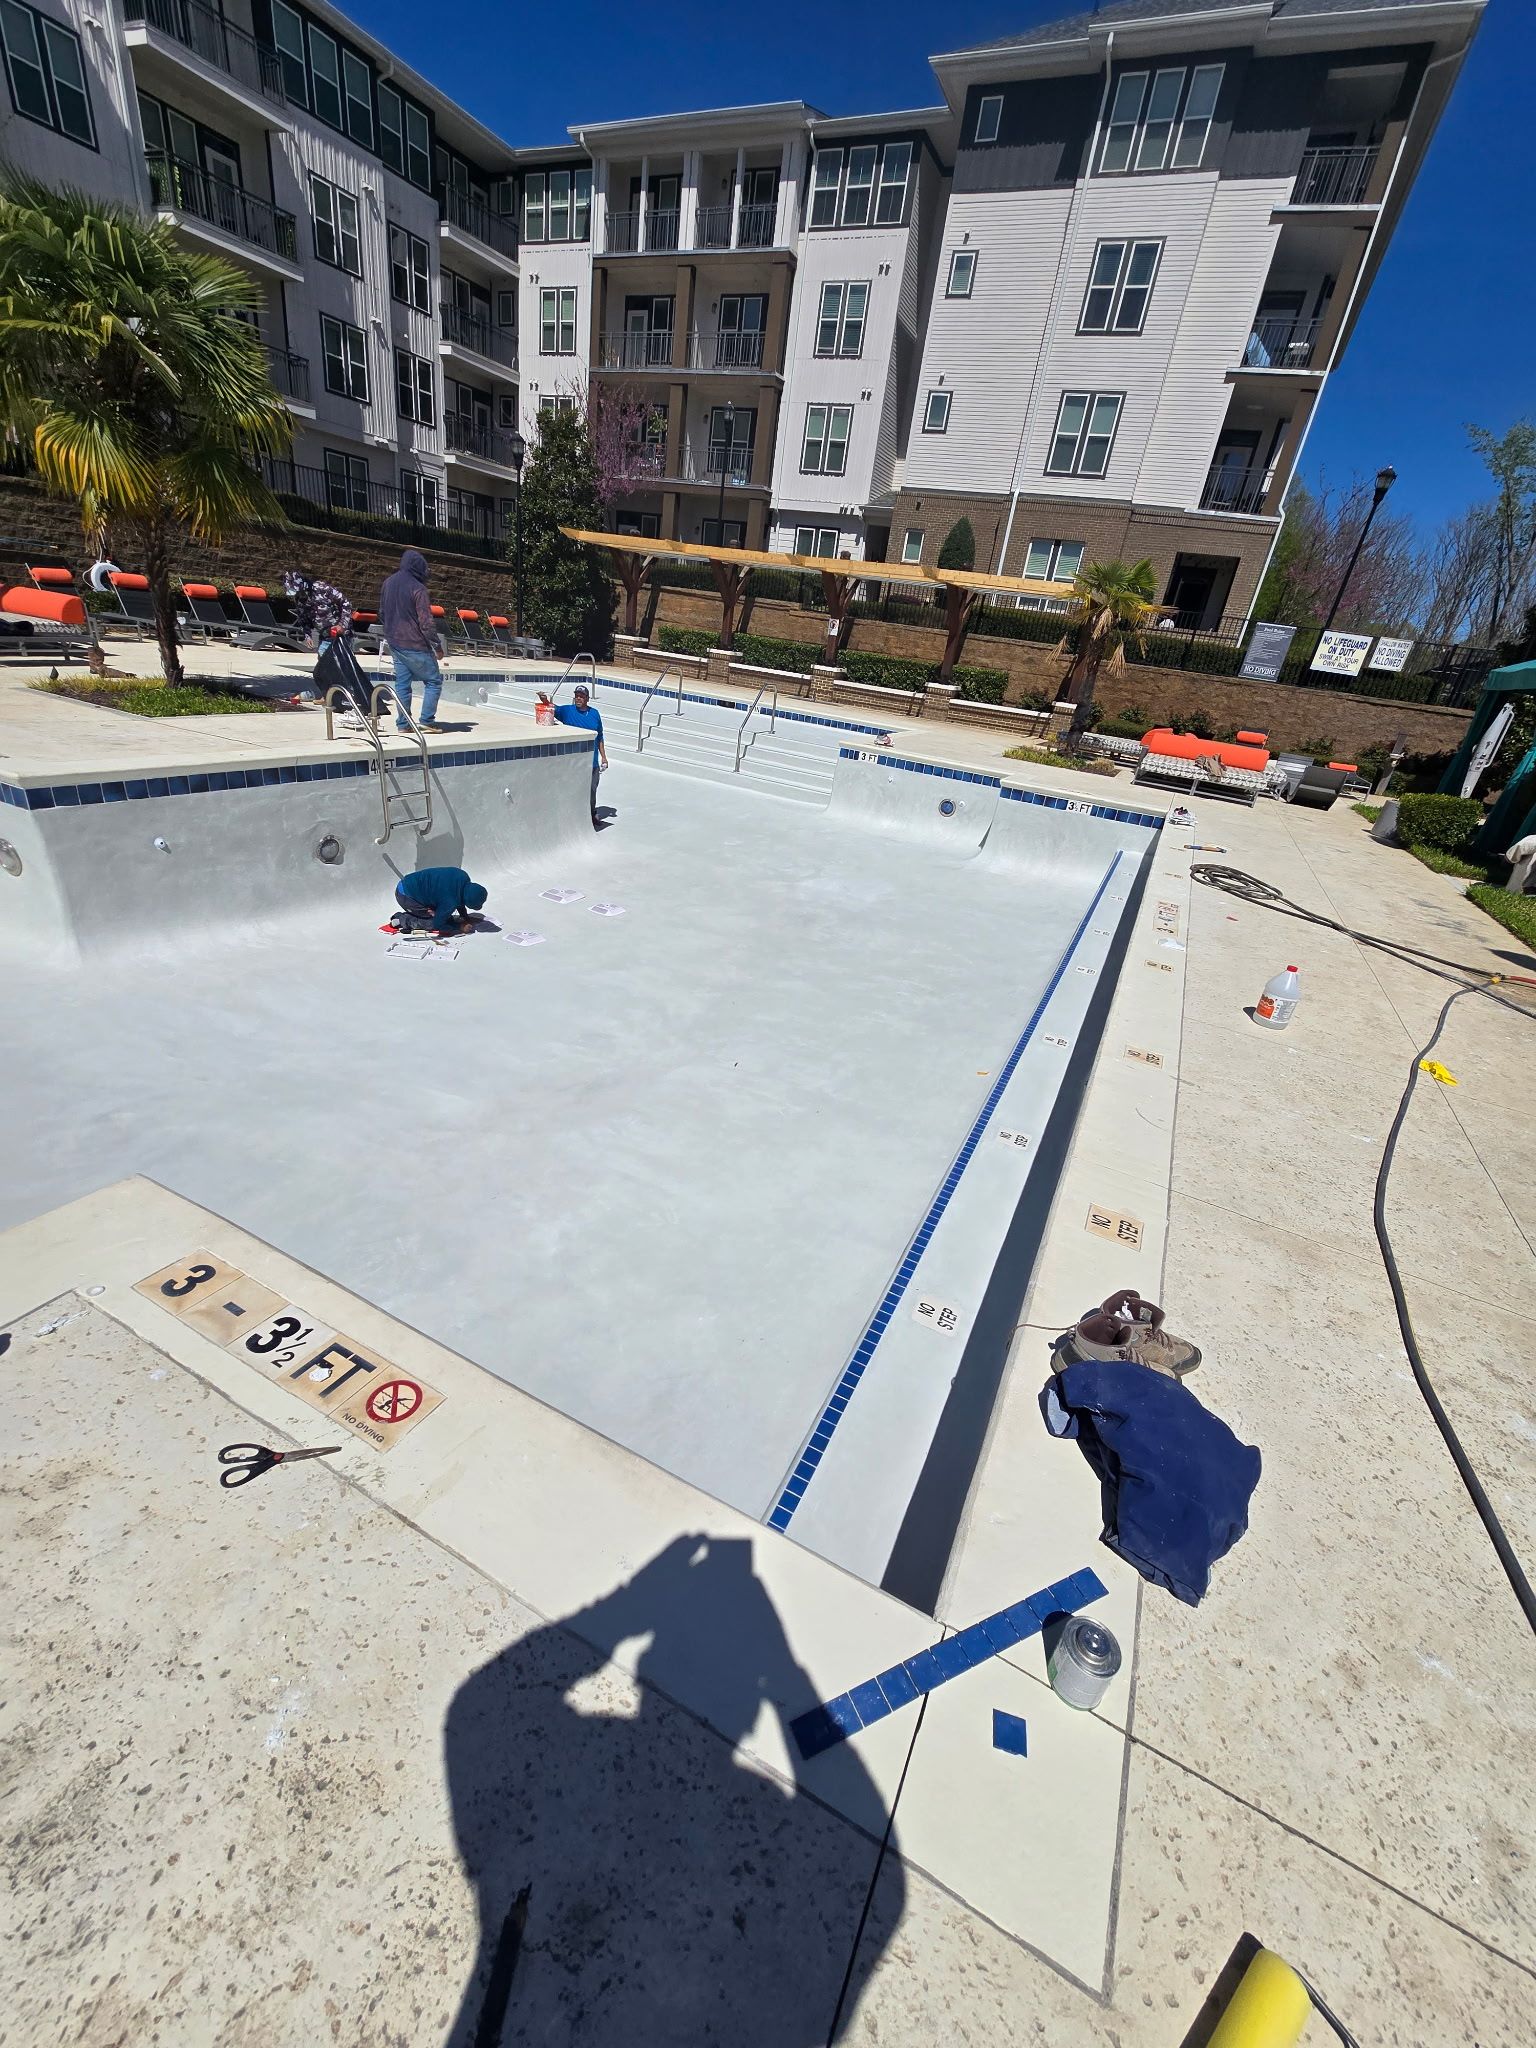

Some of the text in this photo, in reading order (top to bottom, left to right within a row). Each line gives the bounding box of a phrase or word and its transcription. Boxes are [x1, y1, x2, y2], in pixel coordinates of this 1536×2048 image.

[1322, 636, 1368, 650] NO LIFEGUARD
[1328, 646, 1356, 657] ON DUTY
[1377, 647, 1406, 659] NO DIVING
[1374, 657, 1402, 667] ALLOWED
[1254, 667, 1276, 675] DIVING
[861, 752, 877, 763] 3 FT
[1080, 803, 1092, 813] FT
[1091, 1214, 1111, 1229] NO
[1117, 1220, 1138, 1243] STEP
[917, 1302, 935, 1317] NO
[937, 1307, 957, 1330] STEP
[160, 1264, 217, 1297] 3
[289, 1342, 378, 1398] FT
[342, 1412, 385, 1443] NO DIVING
